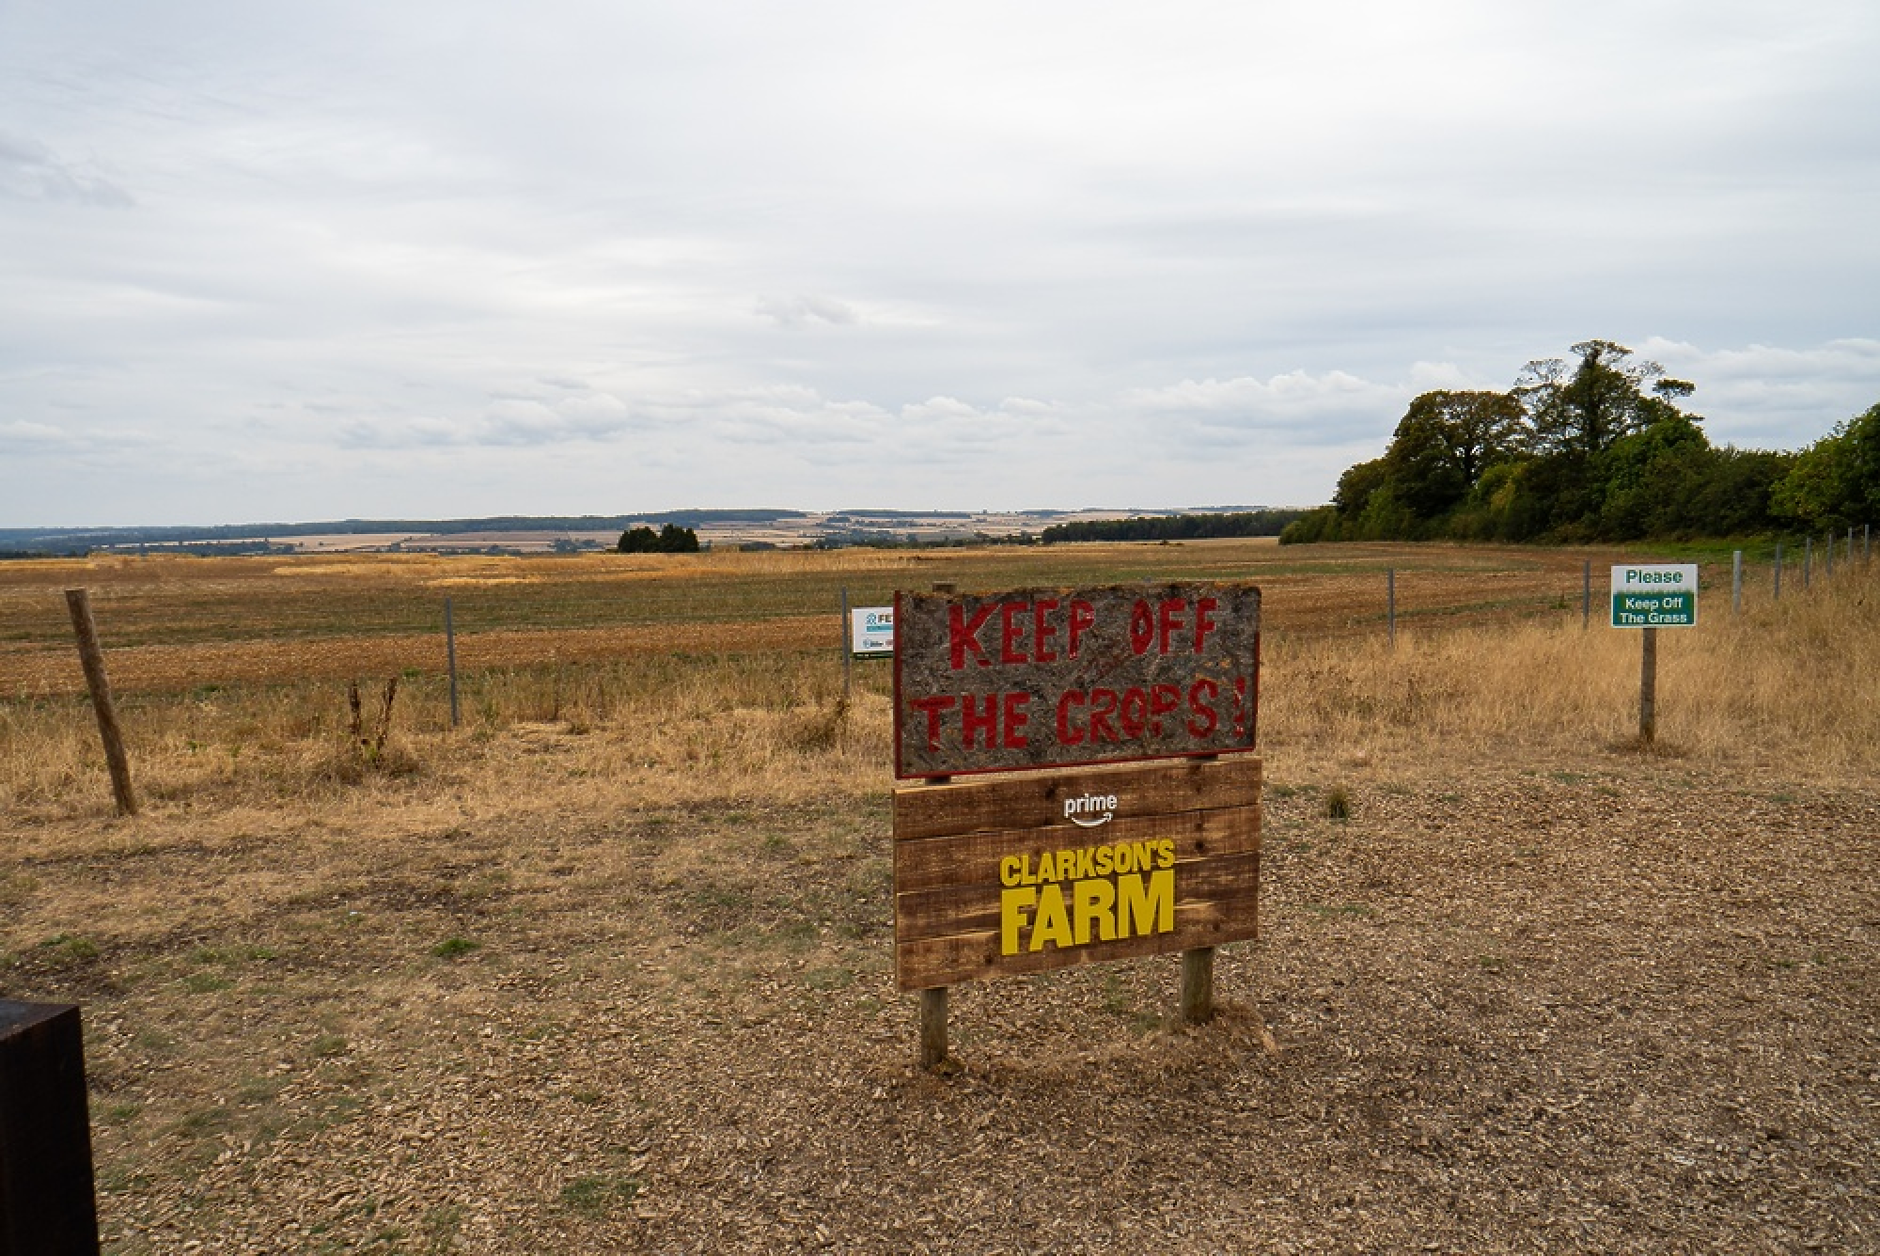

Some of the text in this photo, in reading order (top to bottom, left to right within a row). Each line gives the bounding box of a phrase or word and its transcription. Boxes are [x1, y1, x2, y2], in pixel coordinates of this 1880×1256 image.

[1625, 570, 1684, 584] Please
[1620, 612, 1687, 623] The Grass
[1625, 597, 1683, 612] Keep Off
[948, 597, 1218, 670] KEEP OFF
[911, 692, 1030, 752] THE
[1063, 794, 1118, 818] prime
[1000, 838, 1176, 886] CLARKSON'S
[1001, 869, 1176, 956] FARM
